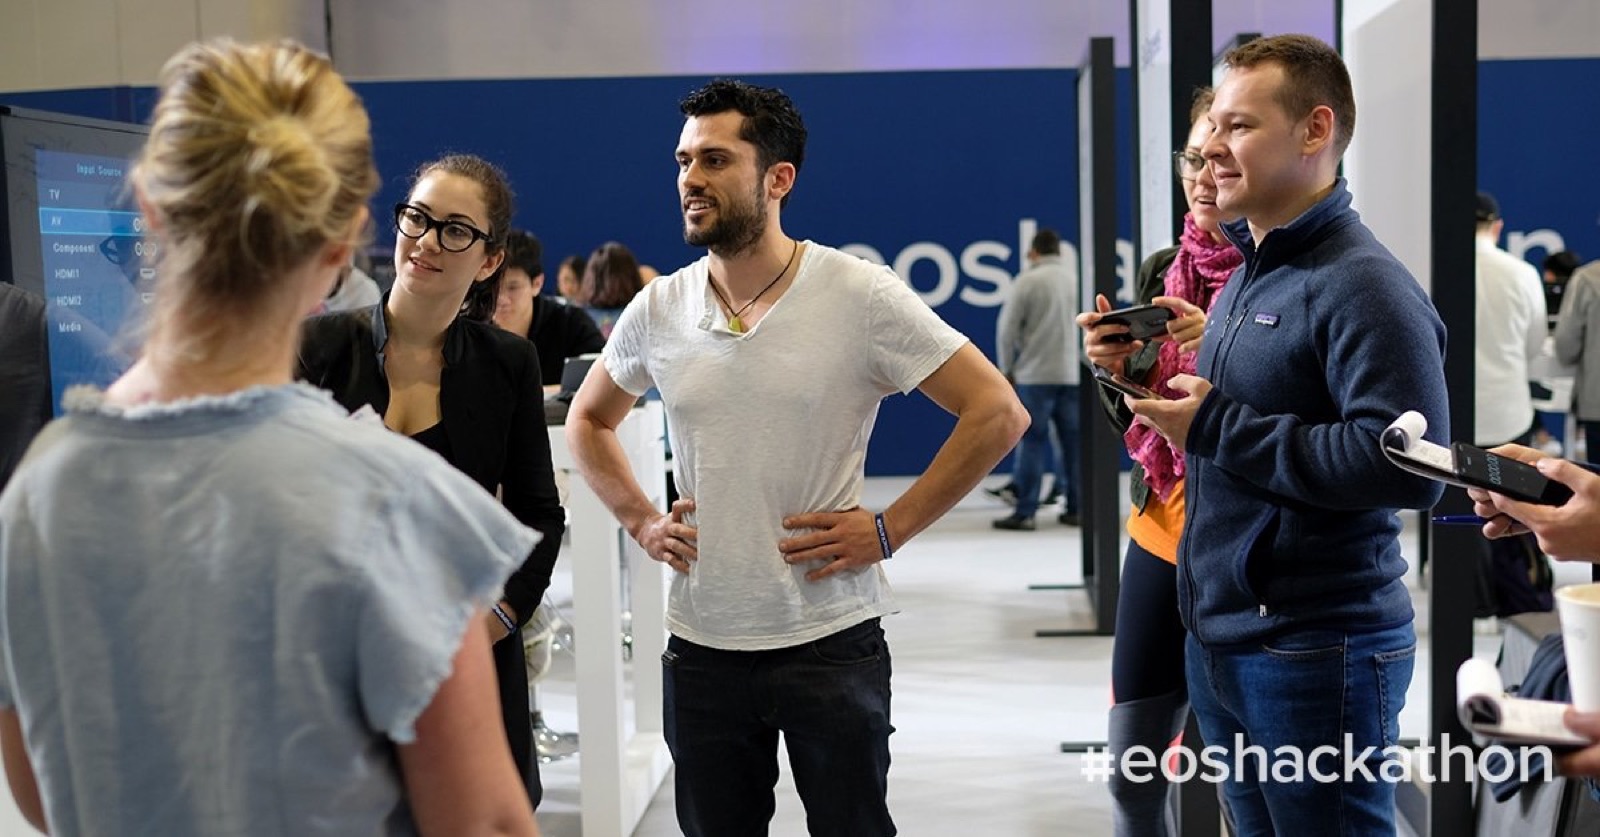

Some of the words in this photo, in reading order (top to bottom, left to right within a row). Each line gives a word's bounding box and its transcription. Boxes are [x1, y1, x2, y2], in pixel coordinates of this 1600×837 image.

[98, 165, 122, 177] Source
[49, 188, 60, 200] TV
[51, 217, 62, 227] AV
[53, 242, 96, 254] Component
[55, 268, 80, 279] HDMI1
[56, 295, 82, 307] HDMI2
[58, 321, 82, 333] Media
